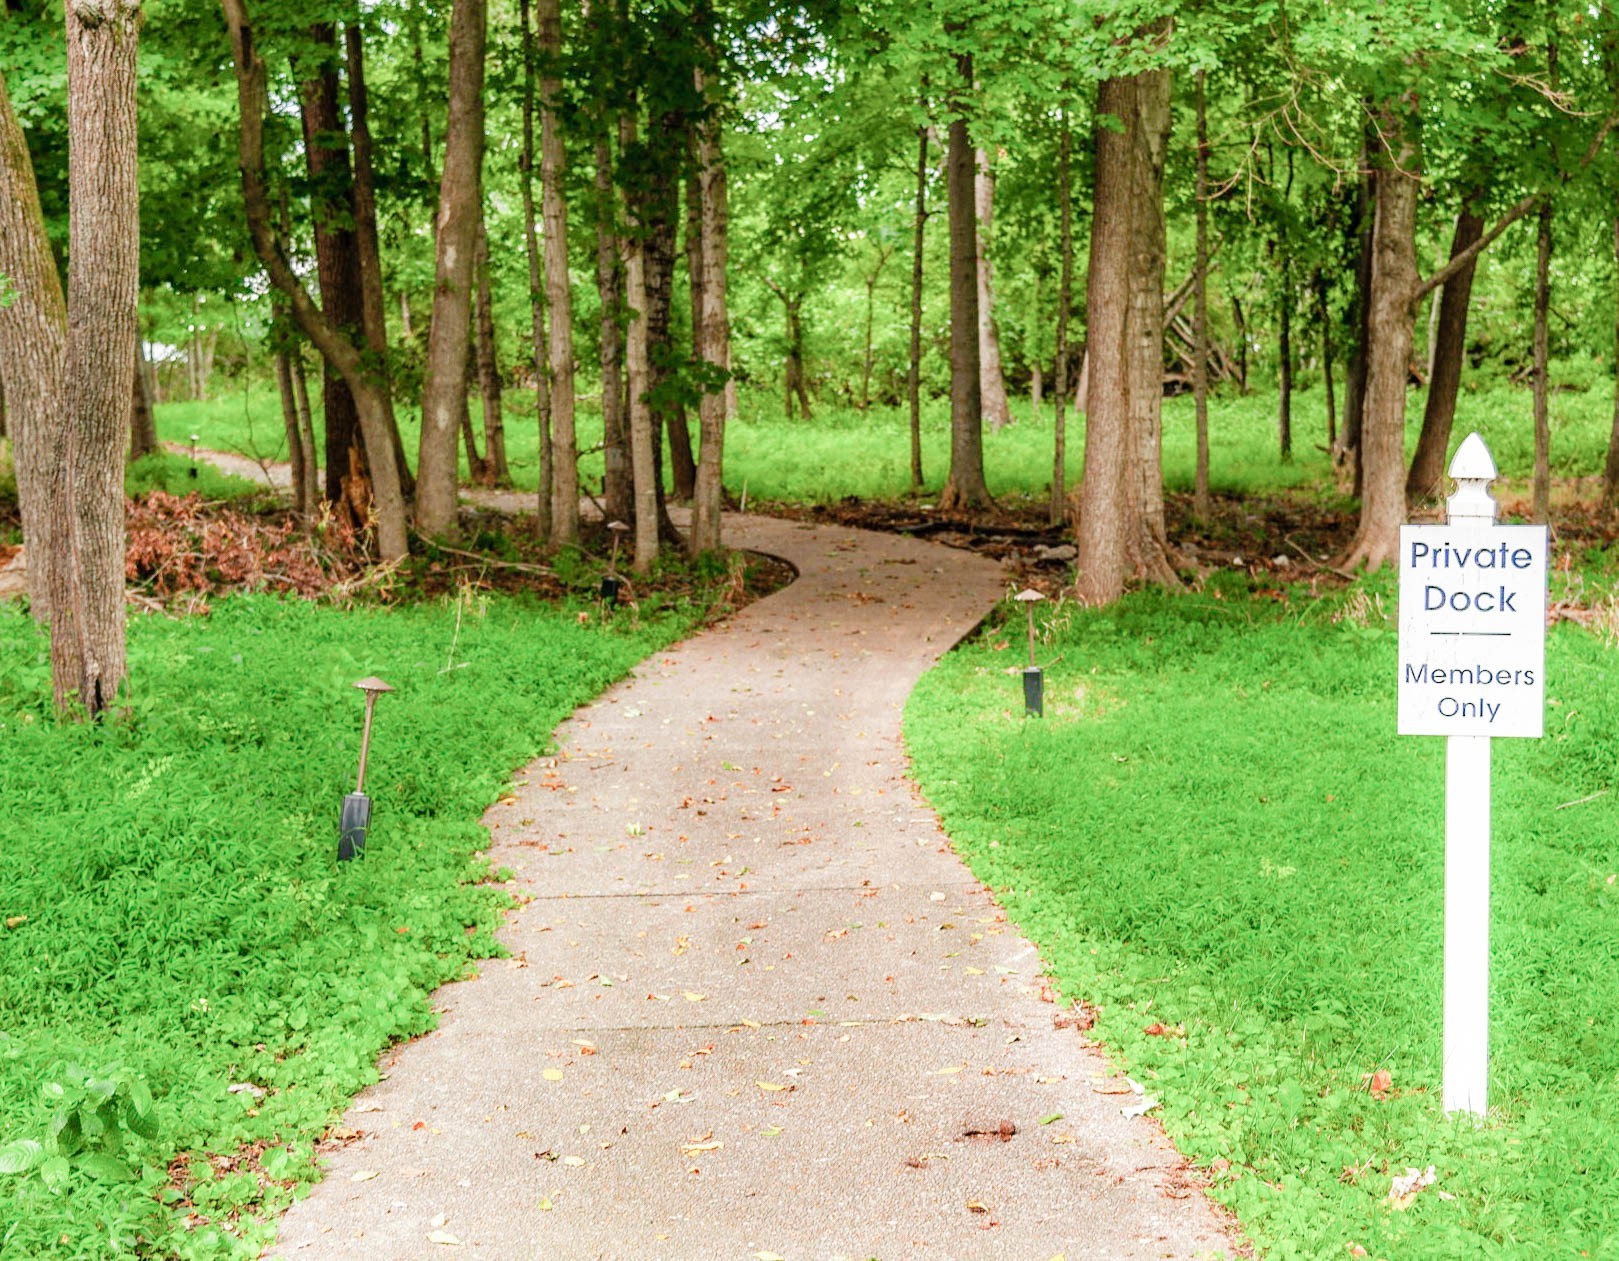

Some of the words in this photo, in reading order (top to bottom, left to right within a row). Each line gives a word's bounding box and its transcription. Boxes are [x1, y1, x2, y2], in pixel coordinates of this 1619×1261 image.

[1411, 541, 1532, 569] Private
[1424, 585, 1517, 612] Dock
[1405, 663, 1535, 686] Members
[1438, 697, 1501, 723] Only
